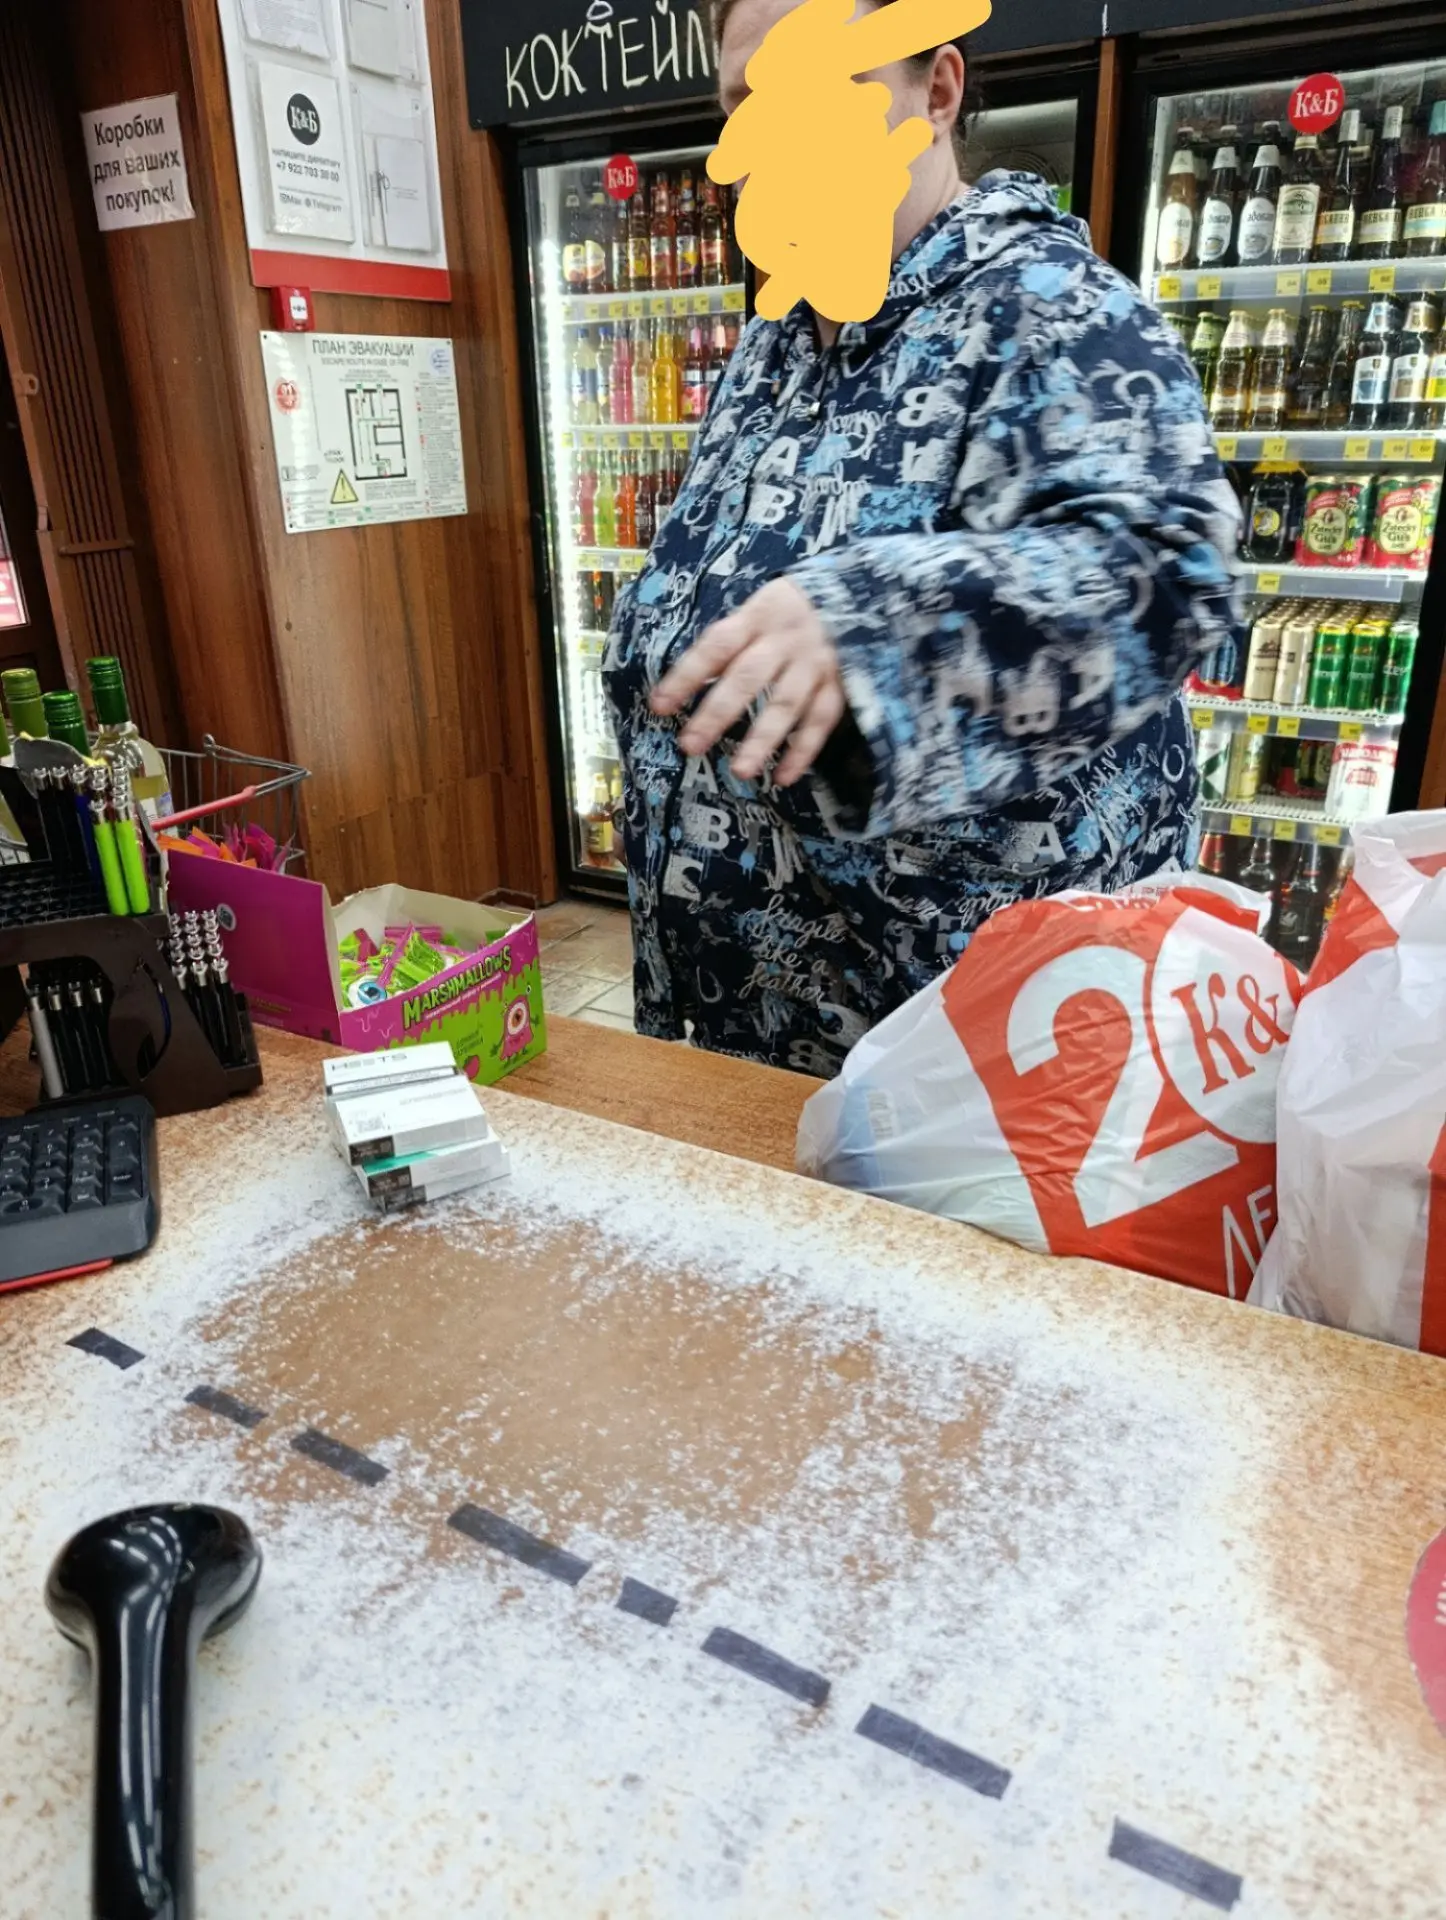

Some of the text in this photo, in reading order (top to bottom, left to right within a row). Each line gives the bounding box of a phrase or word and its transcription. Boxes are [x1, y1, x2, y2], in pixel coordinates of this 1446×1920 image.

[505, 0, 719, 109] КОКТЕЙЛ
[1294, 88, 1338, 119] К&Б
[94, 114, 165, 147] Коробки
[93, 149, 181, 185] для ваших
[607, 166, 635, 189] К&Б
[105, 179, 175, 212] покупок!
[312, 340, 415, 356] ПЛАН ЭВАКУАЦИИ
[403, 944, 512, 1030] MARSHMALLOWS
[1172, 973, 1291, 1096] К&
[1222, 1184, 1274, 1299] ЛЕ
